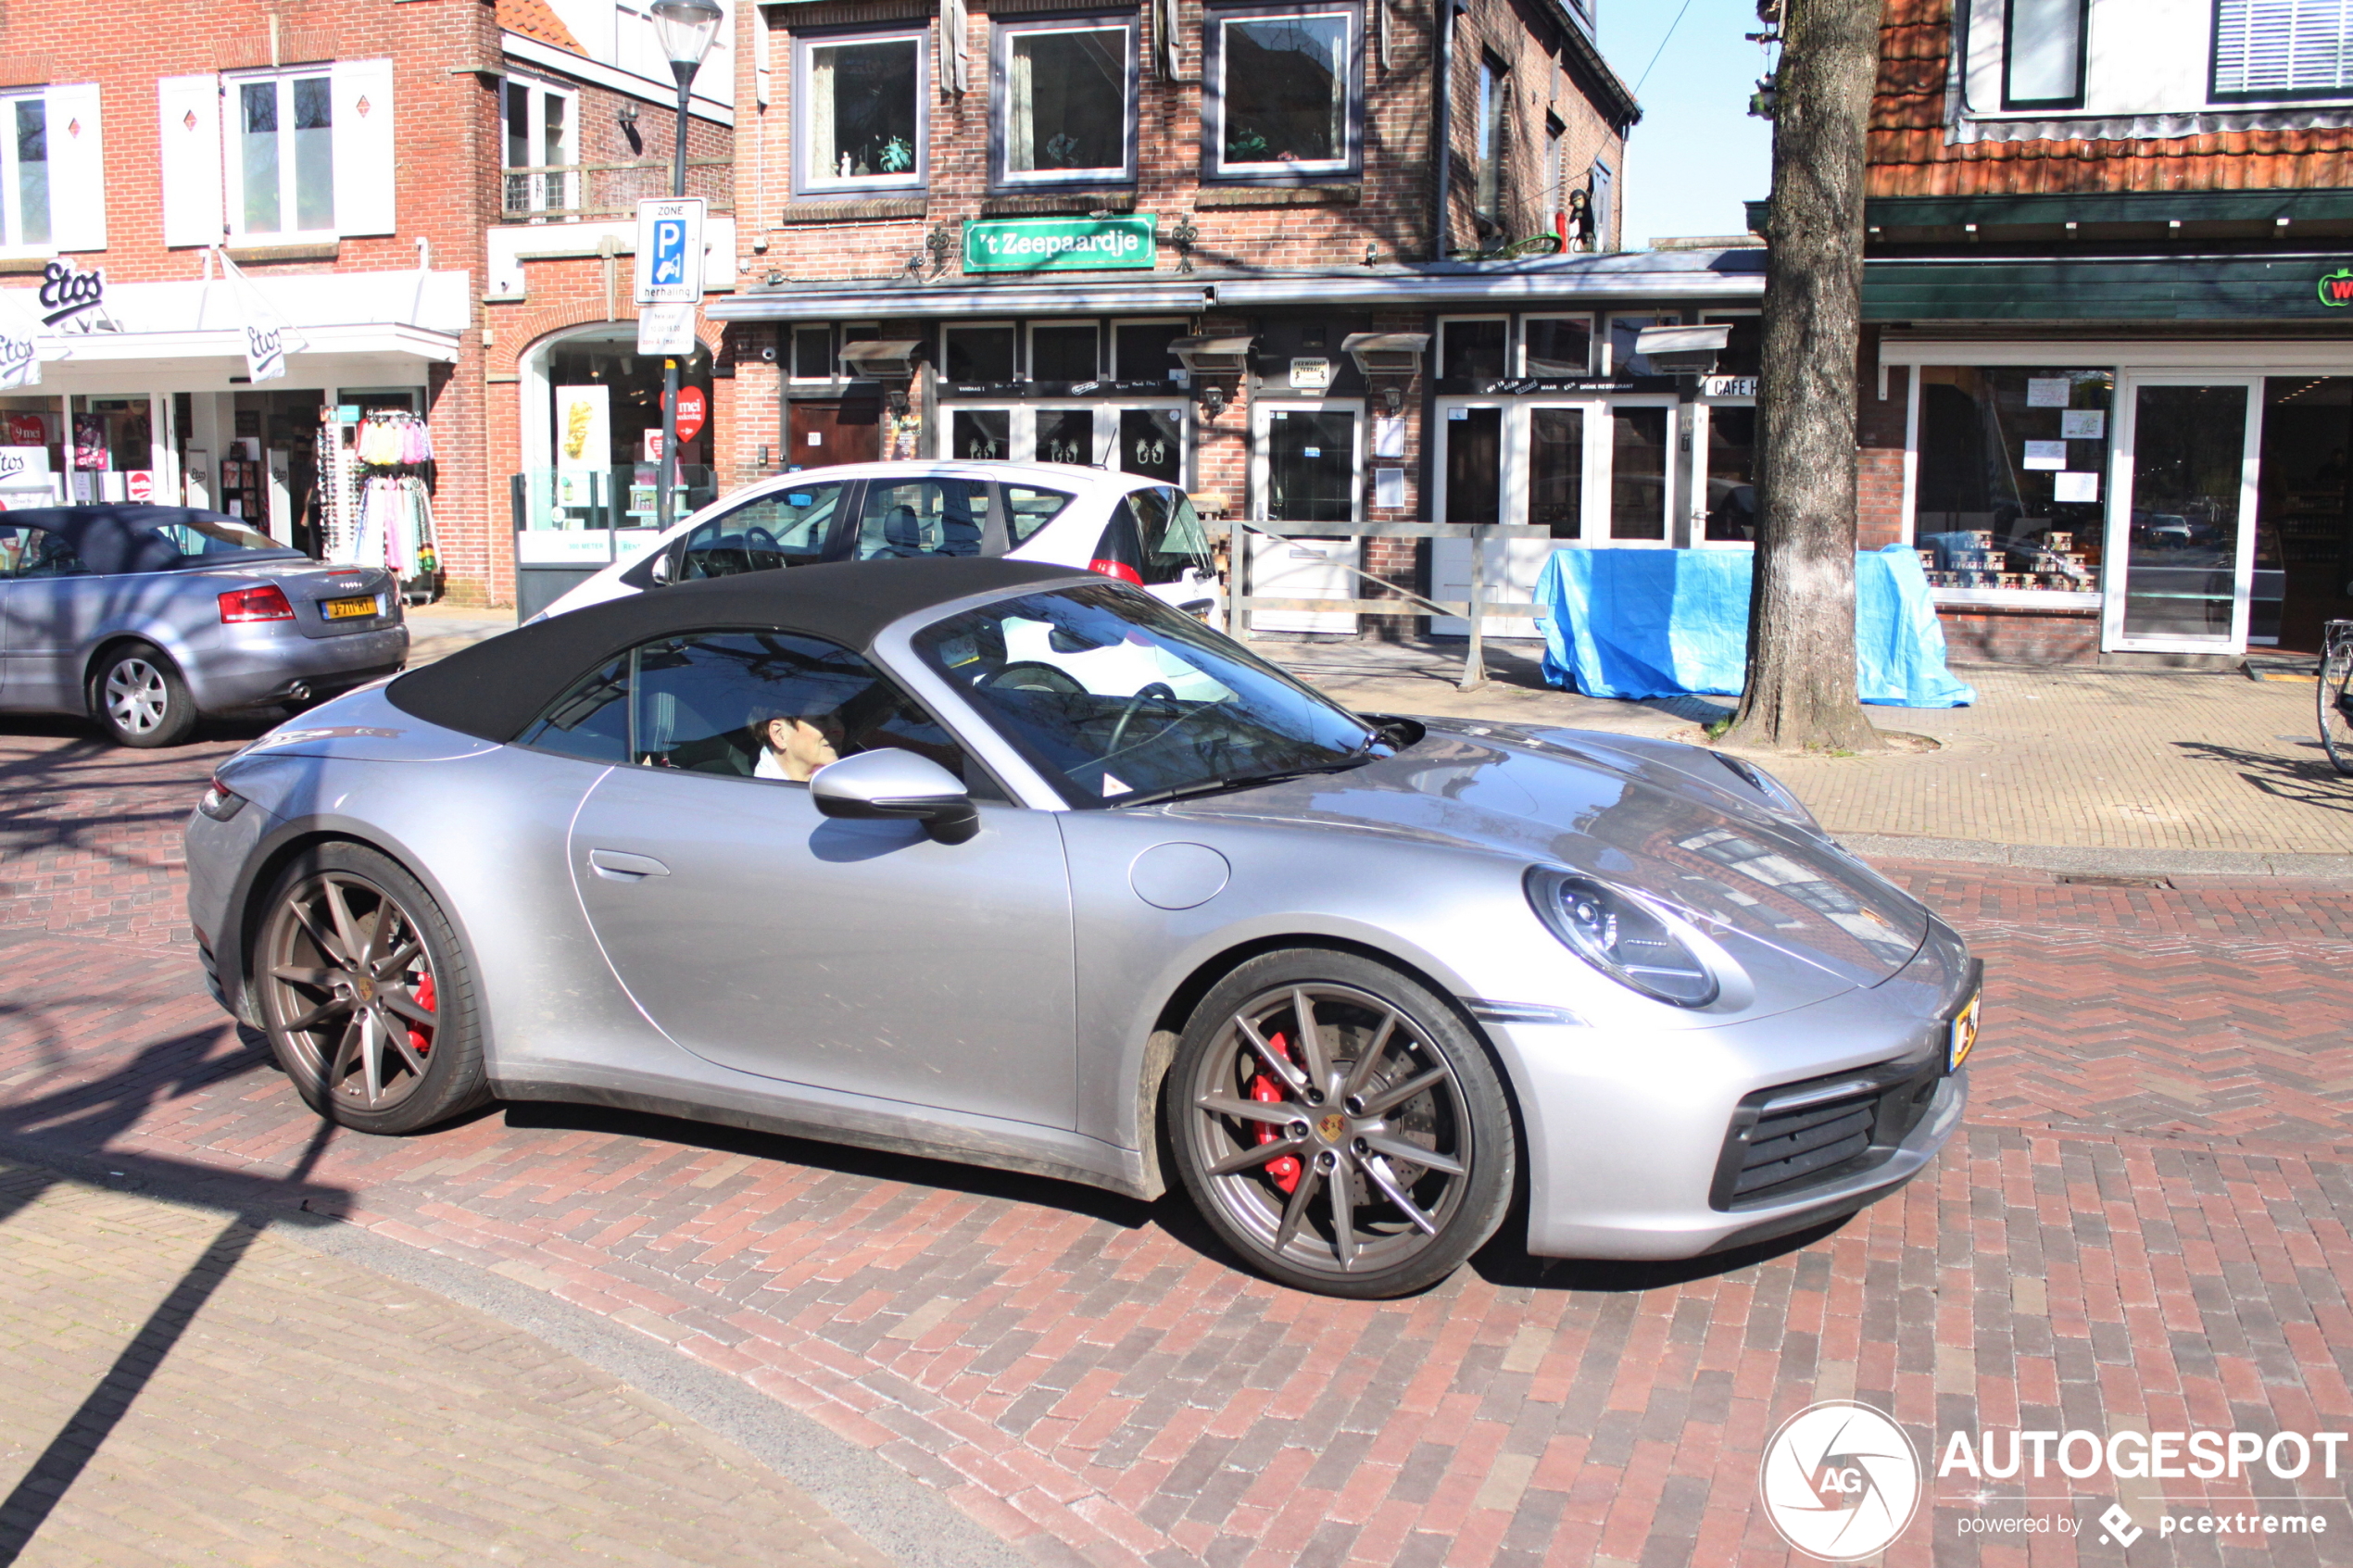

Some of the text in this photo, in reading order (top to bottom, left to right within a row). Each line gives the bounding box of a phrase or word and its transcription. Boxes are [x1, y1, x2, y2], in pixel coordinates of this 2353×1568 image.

[658, 206, 684, 216] ZONE
[659, 222, 680, 258] P
[979, 230, 1139, 257] 't Zeepaardje
[39, 262, 103, 309] Etos
[644, 287, 690, 299] herhaling
[1715, 380, 1745, 395] CAFE
[678, 398, 701, 413] mei
[23, 427, 40, 438] mei
[0, 453, 25, 470] tos
[192, 467, 207, 480] Etos
[273, 467, 287, 480] Etos
